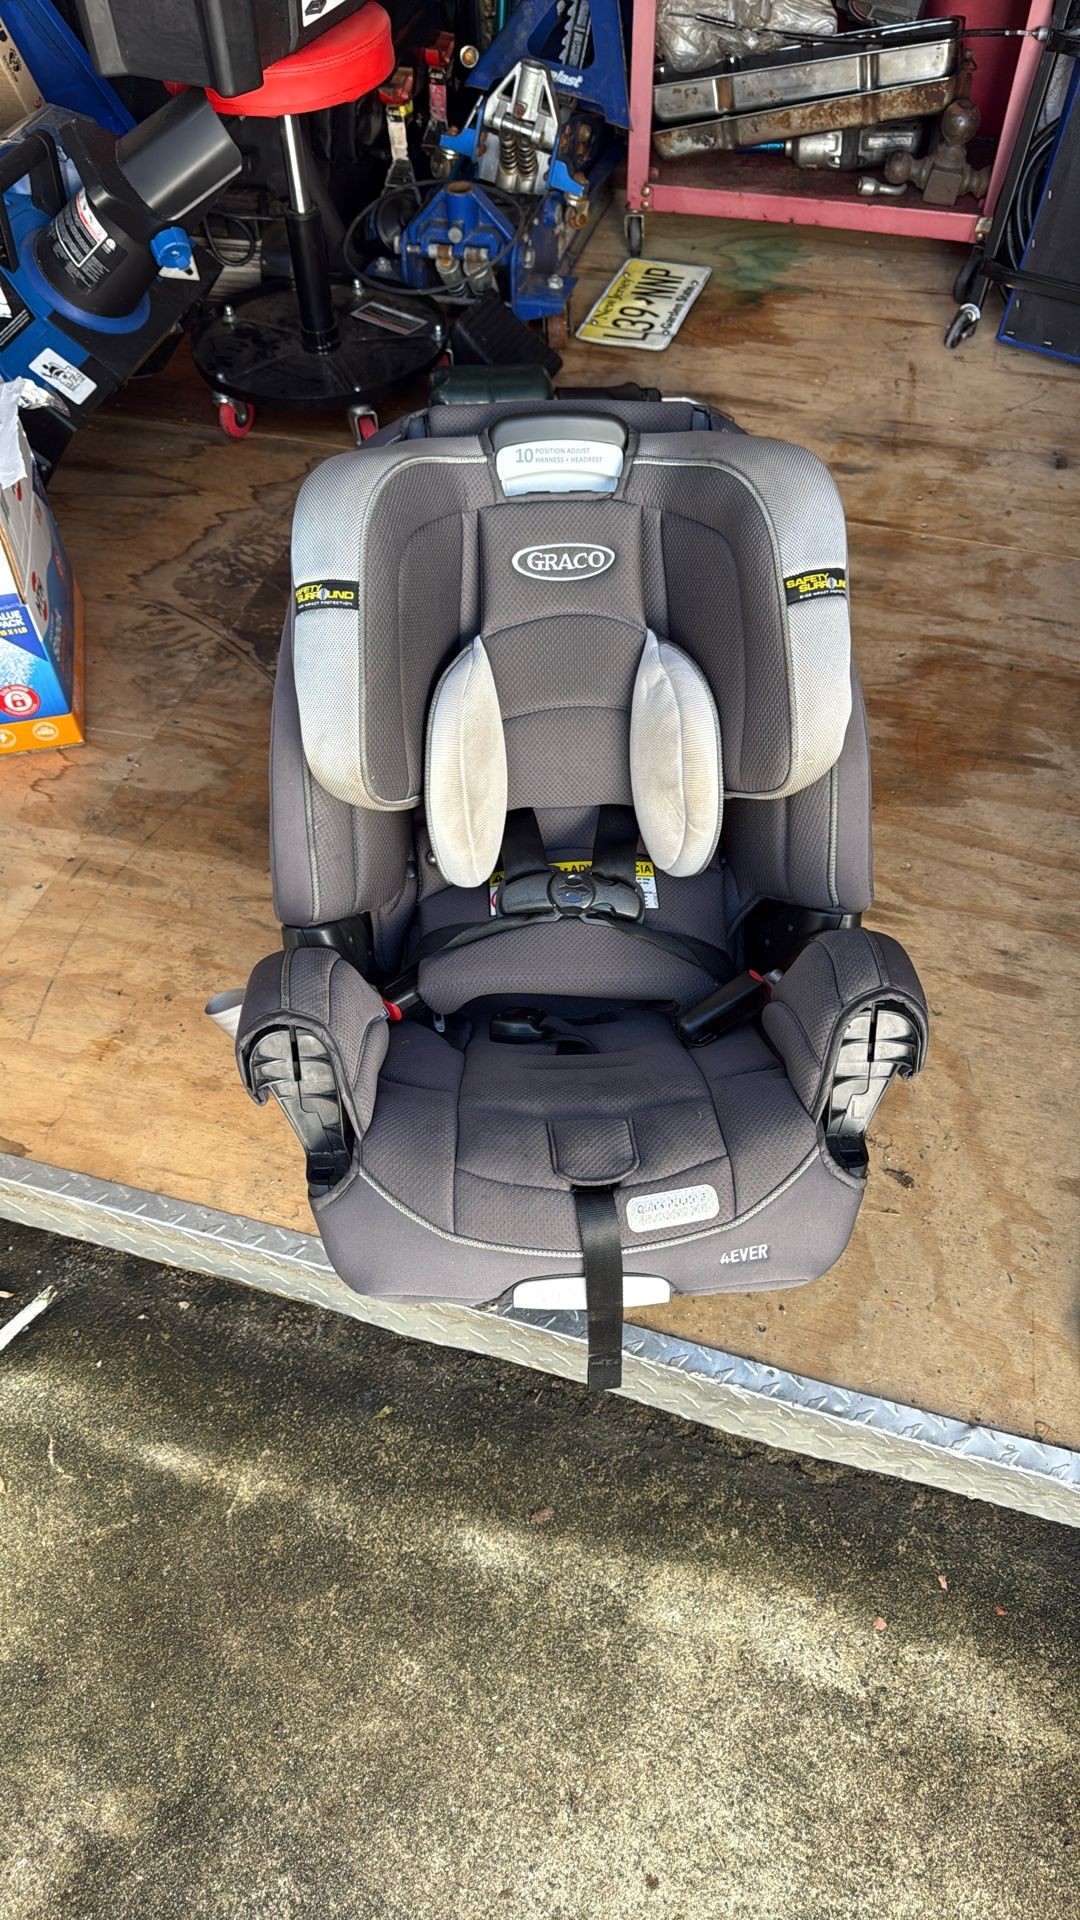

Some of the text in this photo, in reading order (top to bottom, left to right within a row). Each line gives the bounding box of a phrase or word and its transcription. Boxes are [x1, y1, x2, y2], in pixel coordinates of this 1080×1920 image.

[594, 278, 634, 320] New Jersey
[661, 284, 696, 330] Garden State
[515, 447, 590, 463] 10 POSITION ADJUST
[526, 551, 605, 571] GRACO
[786, 572, 829, 588] SAFETY
[720, 1244, 768, 1265] 4EVER
